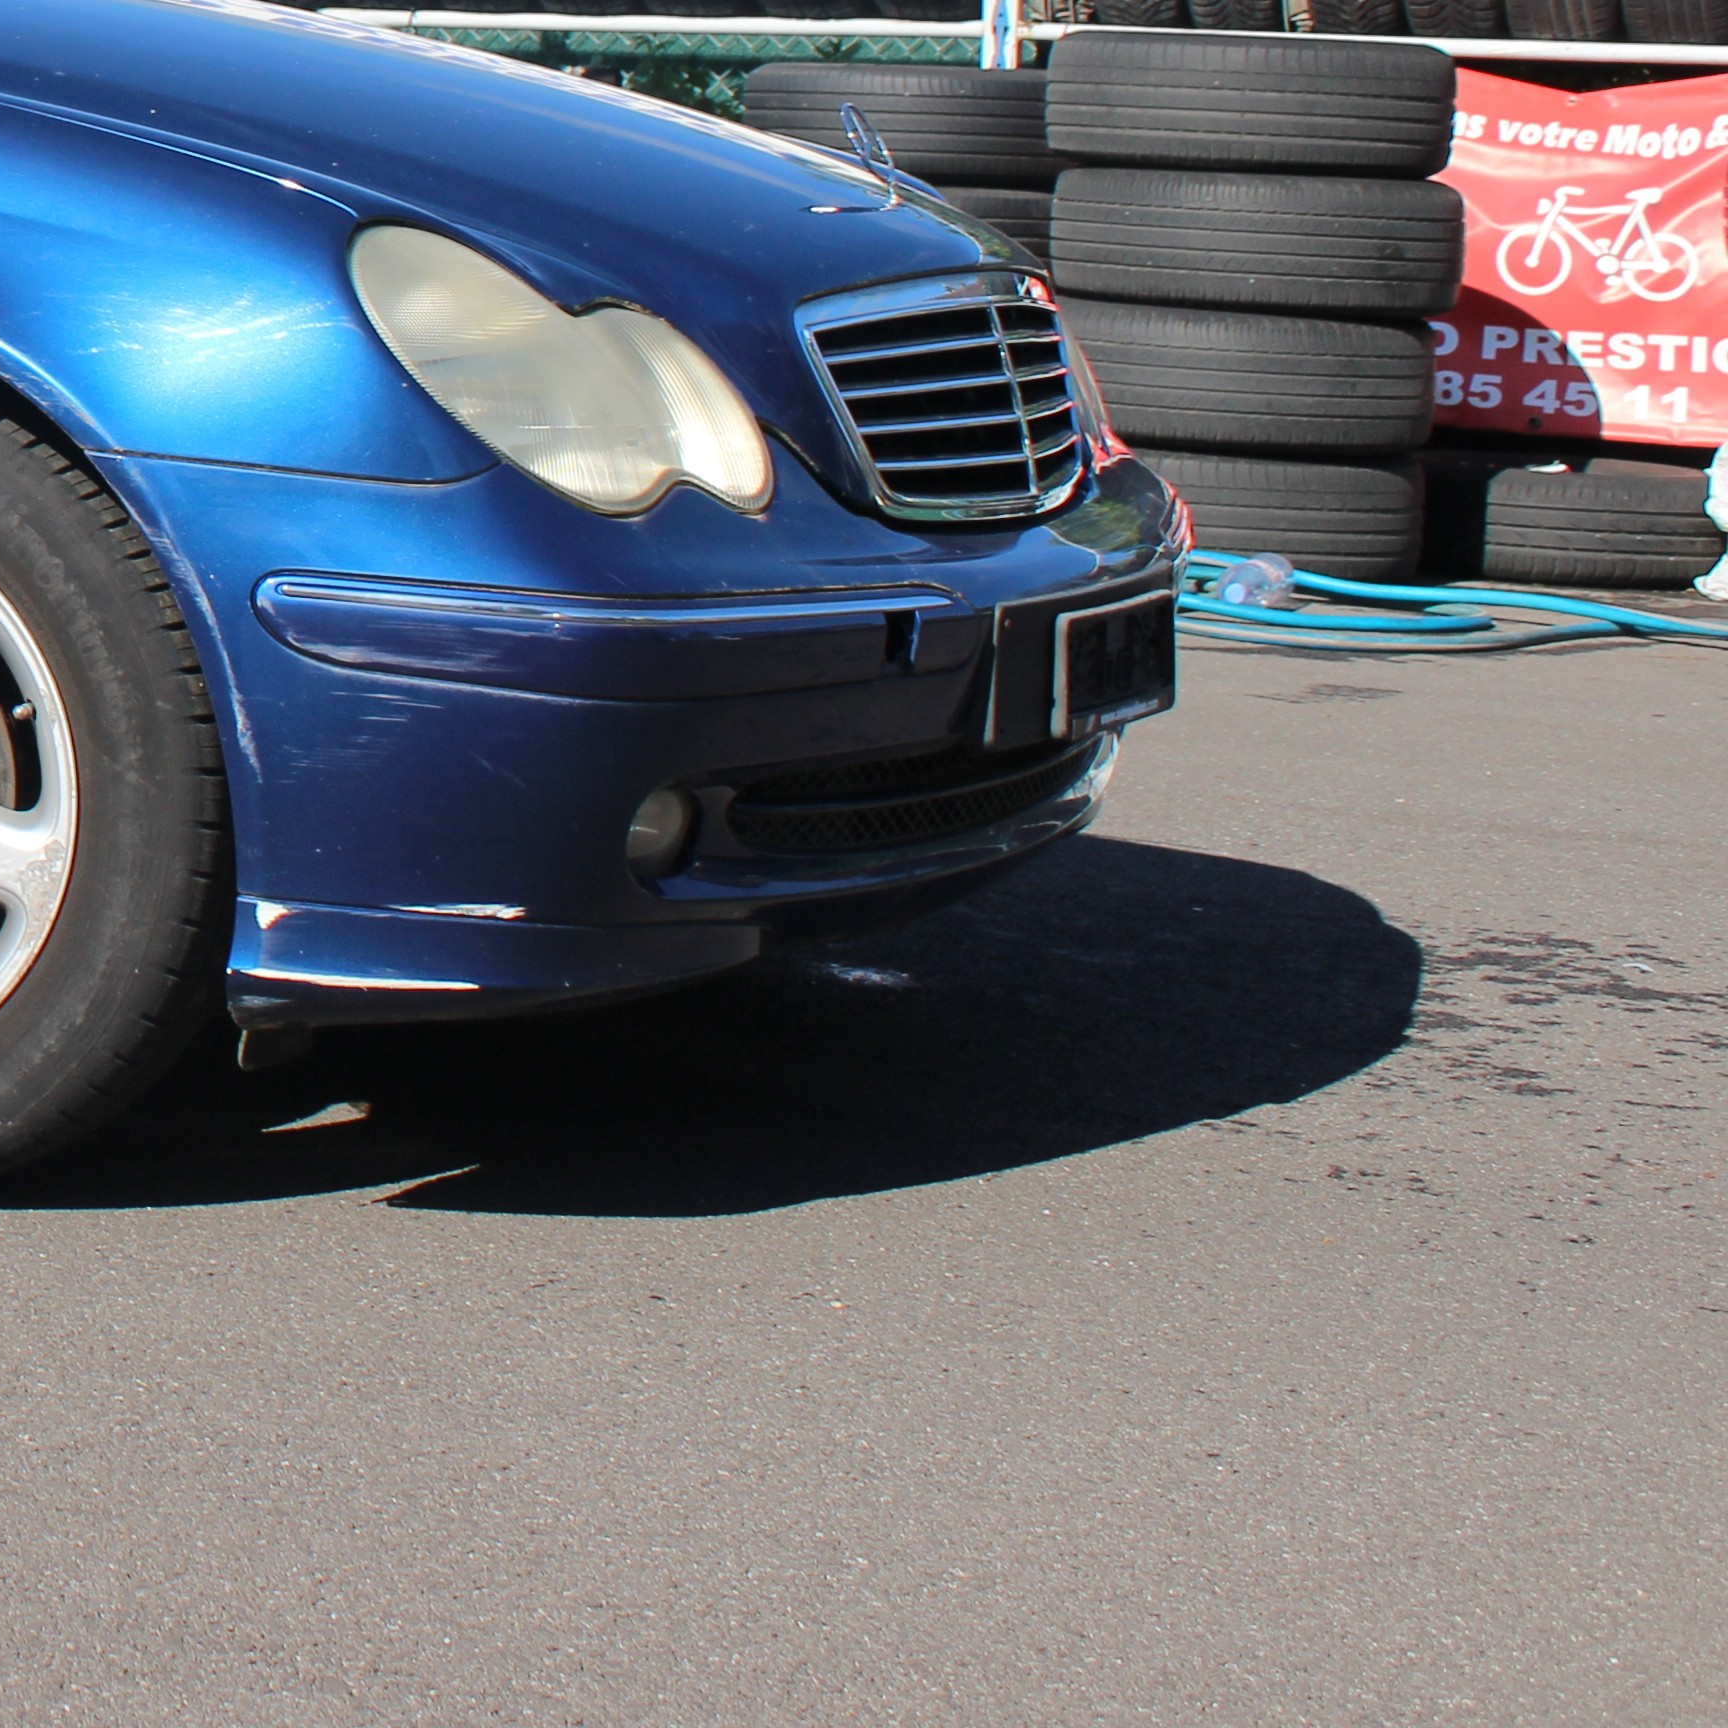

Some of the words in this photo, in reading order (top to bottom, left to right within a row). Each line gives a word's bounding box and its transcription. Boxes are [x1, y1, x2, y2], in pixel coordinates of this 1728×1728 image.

[1498, 117, 1597, 152] votre
[1601, 122, 1702, 160] Moto
[1522, 378, 1598, 417] 45
[1623, 384, 1690, 423] 11
